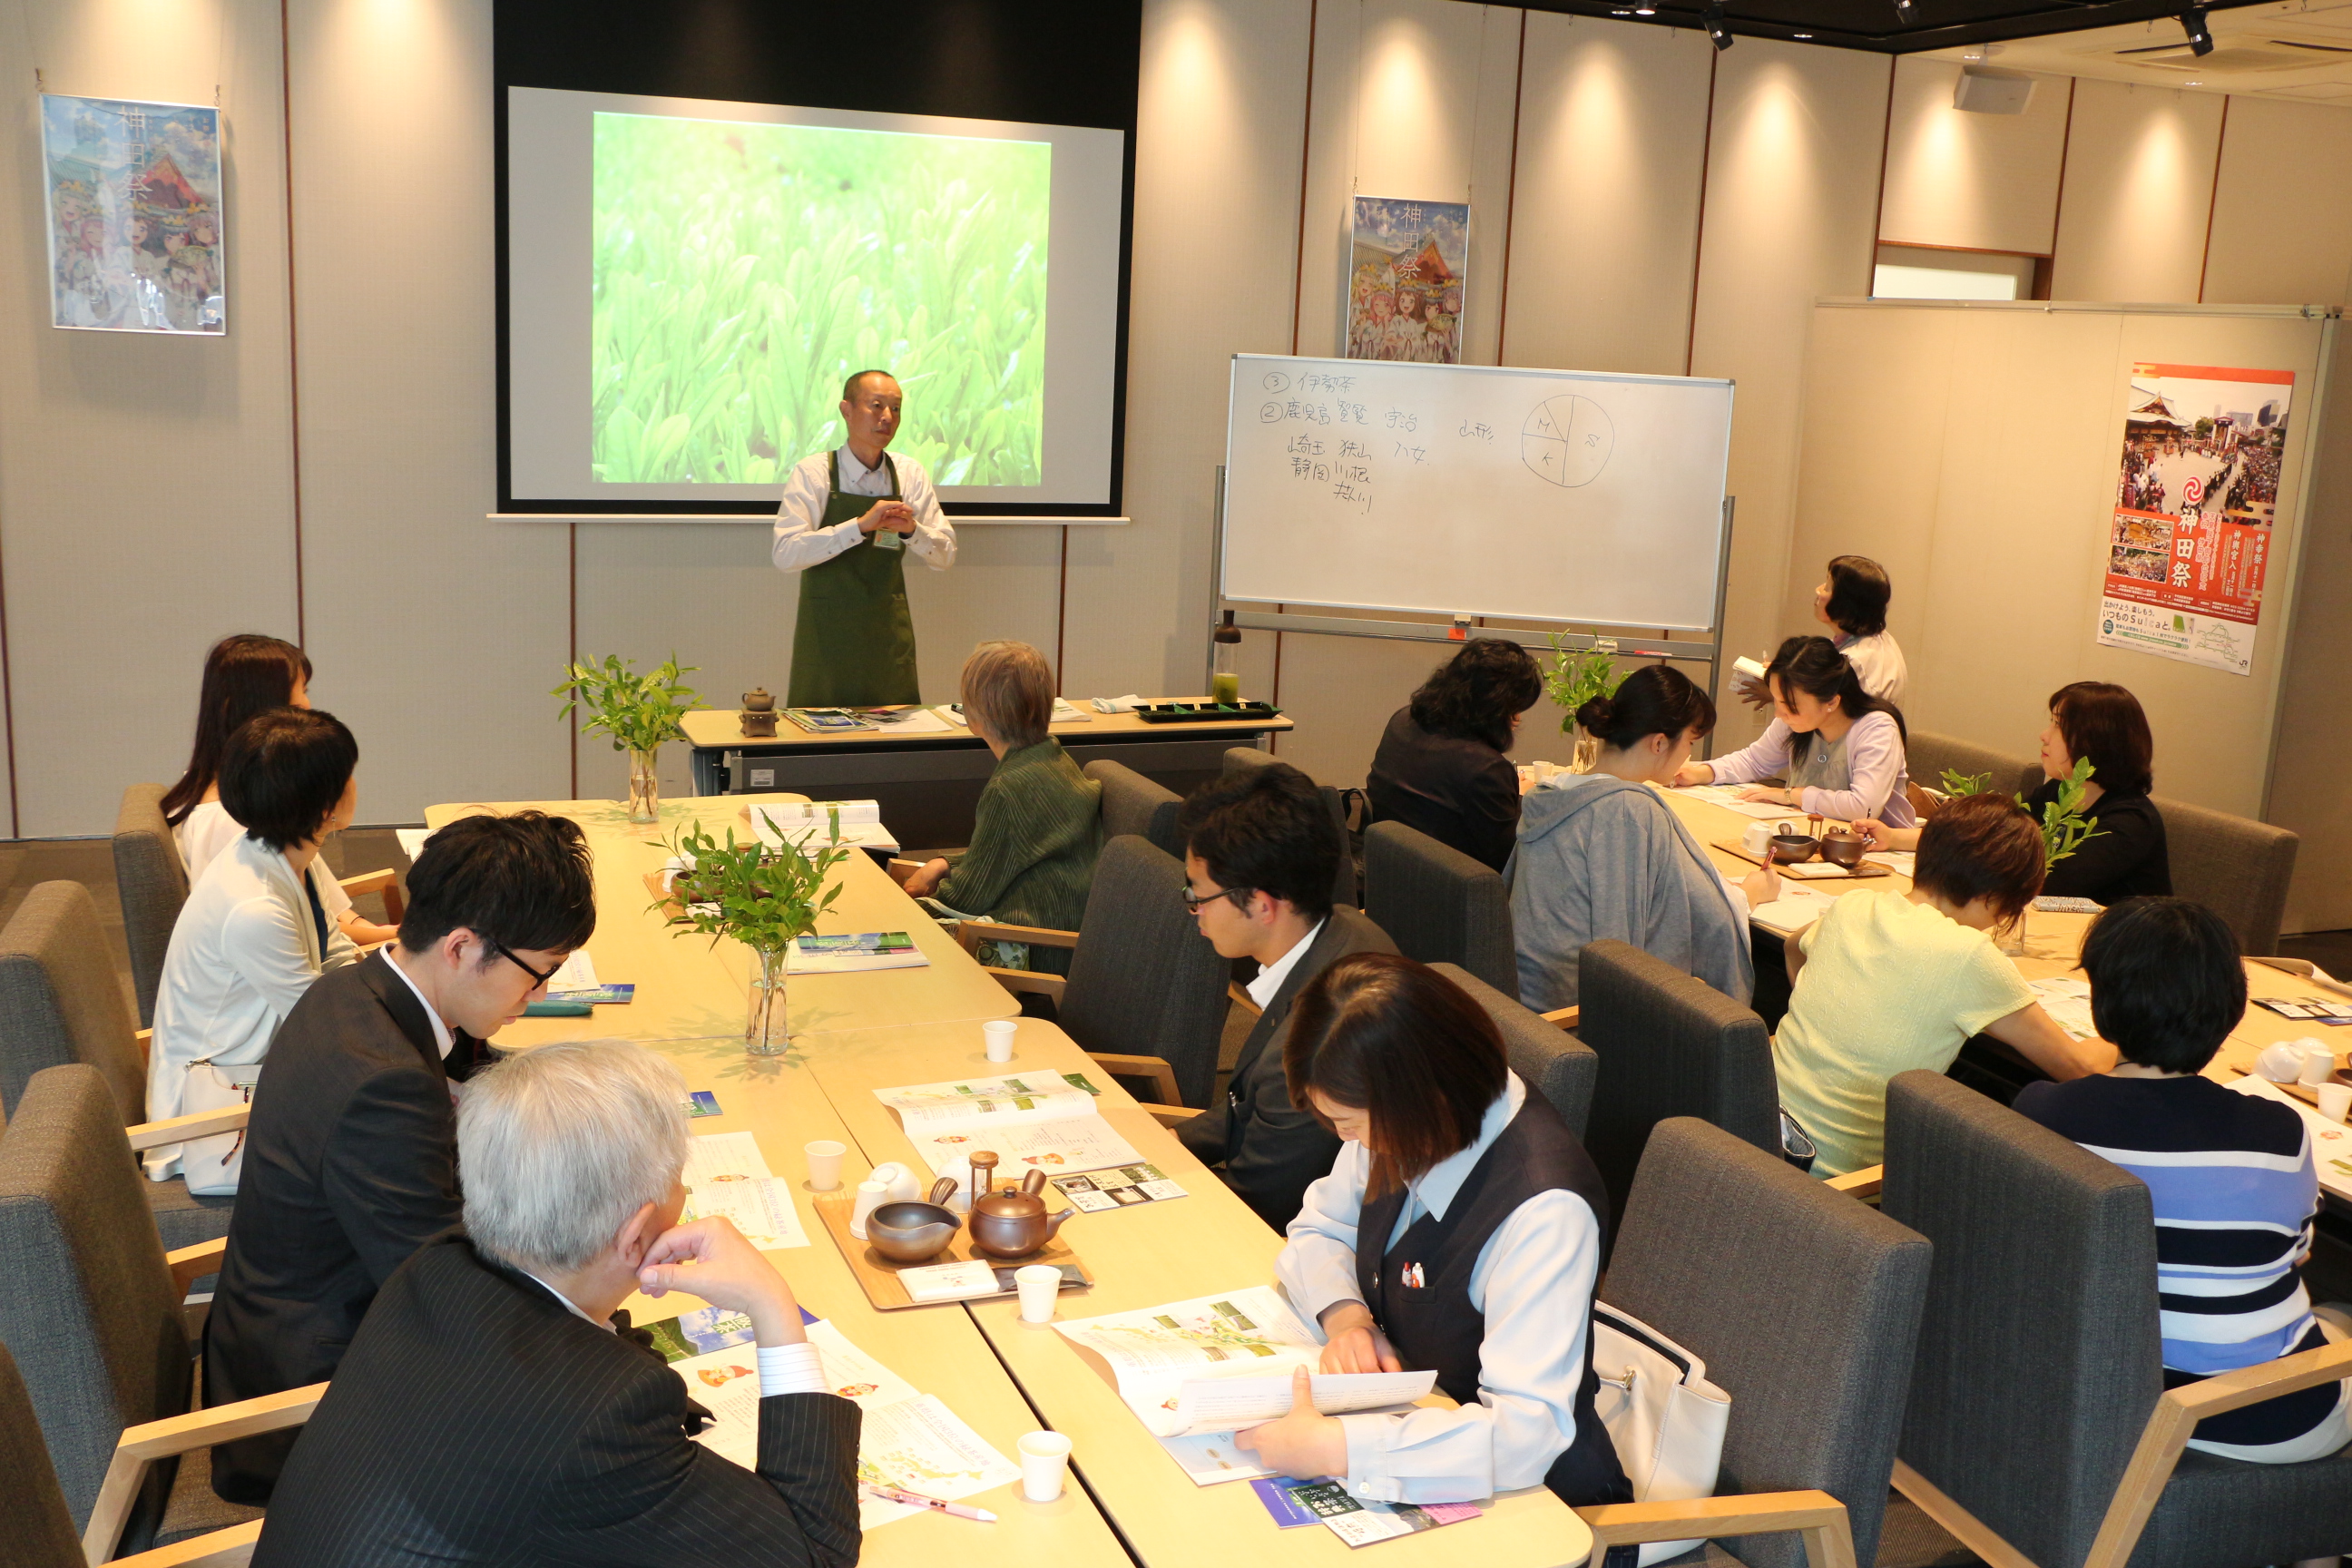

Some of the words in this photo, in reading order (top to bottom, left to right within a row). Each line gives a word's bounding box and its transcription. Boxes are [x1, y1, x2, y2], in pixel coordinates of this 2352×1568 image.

[114, 105, 153, 200] 神田祭
[1397, 203, 1422, 279] 神田祭
[1298, 372, 1357, 393] 伊勢茶
[1284, 397, 1331, 425] 鹿児島
[1385, 407, 1417, 432] 宇治
[1537, 417, 1551, 432] M
[1459, 419, 1494, 441] 山形
[1584, 434, 1601, 447] S
[1338, 439, 1372, 461] 狭山
[1542, 452, 1553, 466] K
[1291, 456, 1329, 482] 静岡
[2171, 508, 2199, 588] 神田祭
[2254, 534, 2266, 564] 神幸祭
